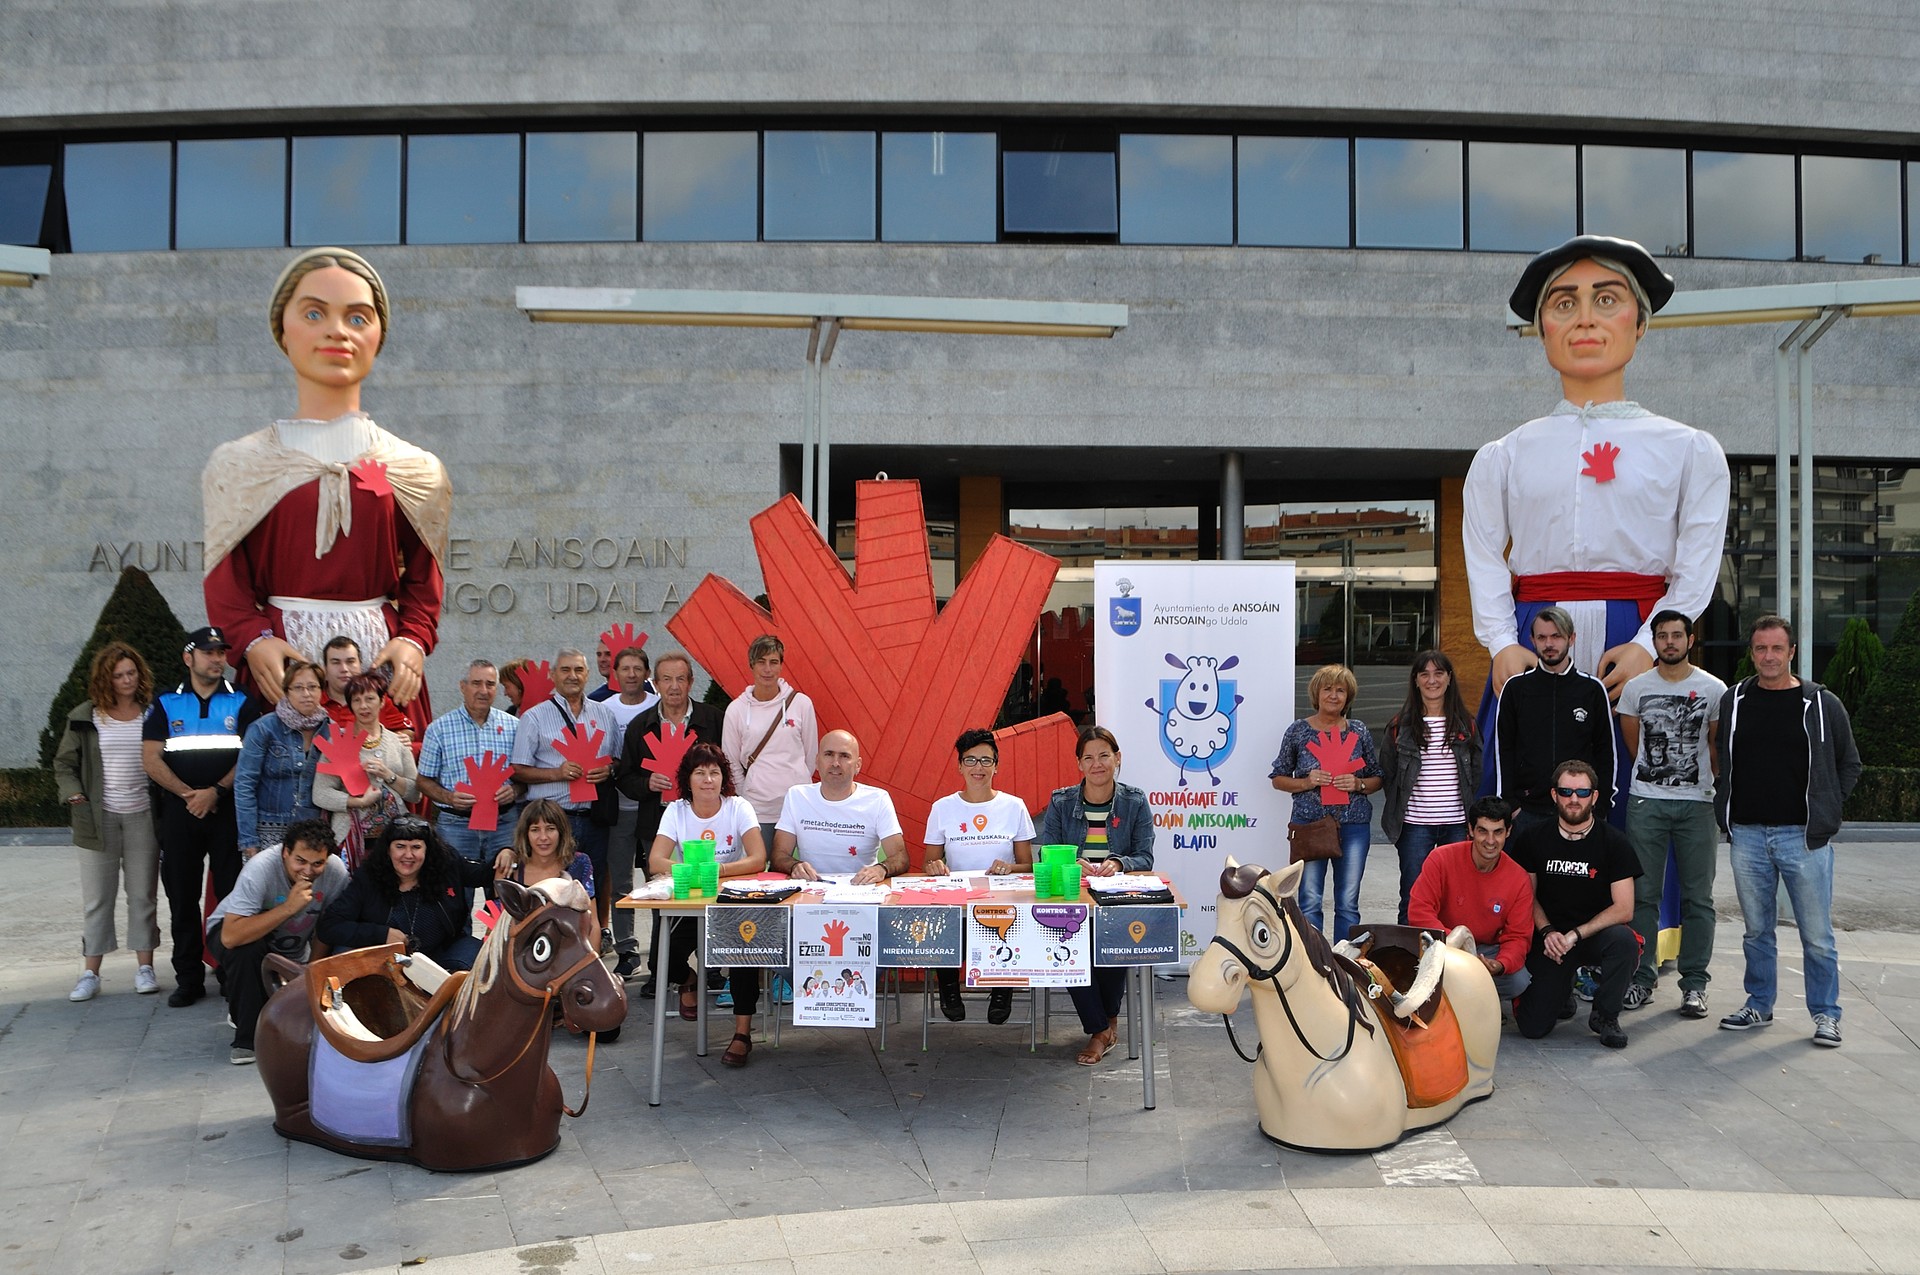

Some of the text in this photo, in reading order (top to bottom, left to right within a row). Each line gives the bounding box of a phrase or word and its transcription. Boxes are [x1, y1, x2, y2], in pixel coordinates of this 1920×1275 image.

[88, 536, 687, 573] AYUNT E ANSOAIN
[546, 581, 683, 614] UDALA
[1153, 600, 1280, 614] Ayuntamiento de ANSOÁIN
[1153, 615, 1248, 627] ANTSOAINgo Udala
[1222, 791, 1239, 807] DE
[1153, 809, 1184, 830] OÁIN
[1173, 833, 1217, 852] BLAITU
[1200, 905, 1216, 913] NIR
[857, 945, 871, 957] NO
[882, 947, 955, 955] NIREKIN EUSKARAZ
[1100, 945, 1174, 955] NIREKIN EUSKARAZ
